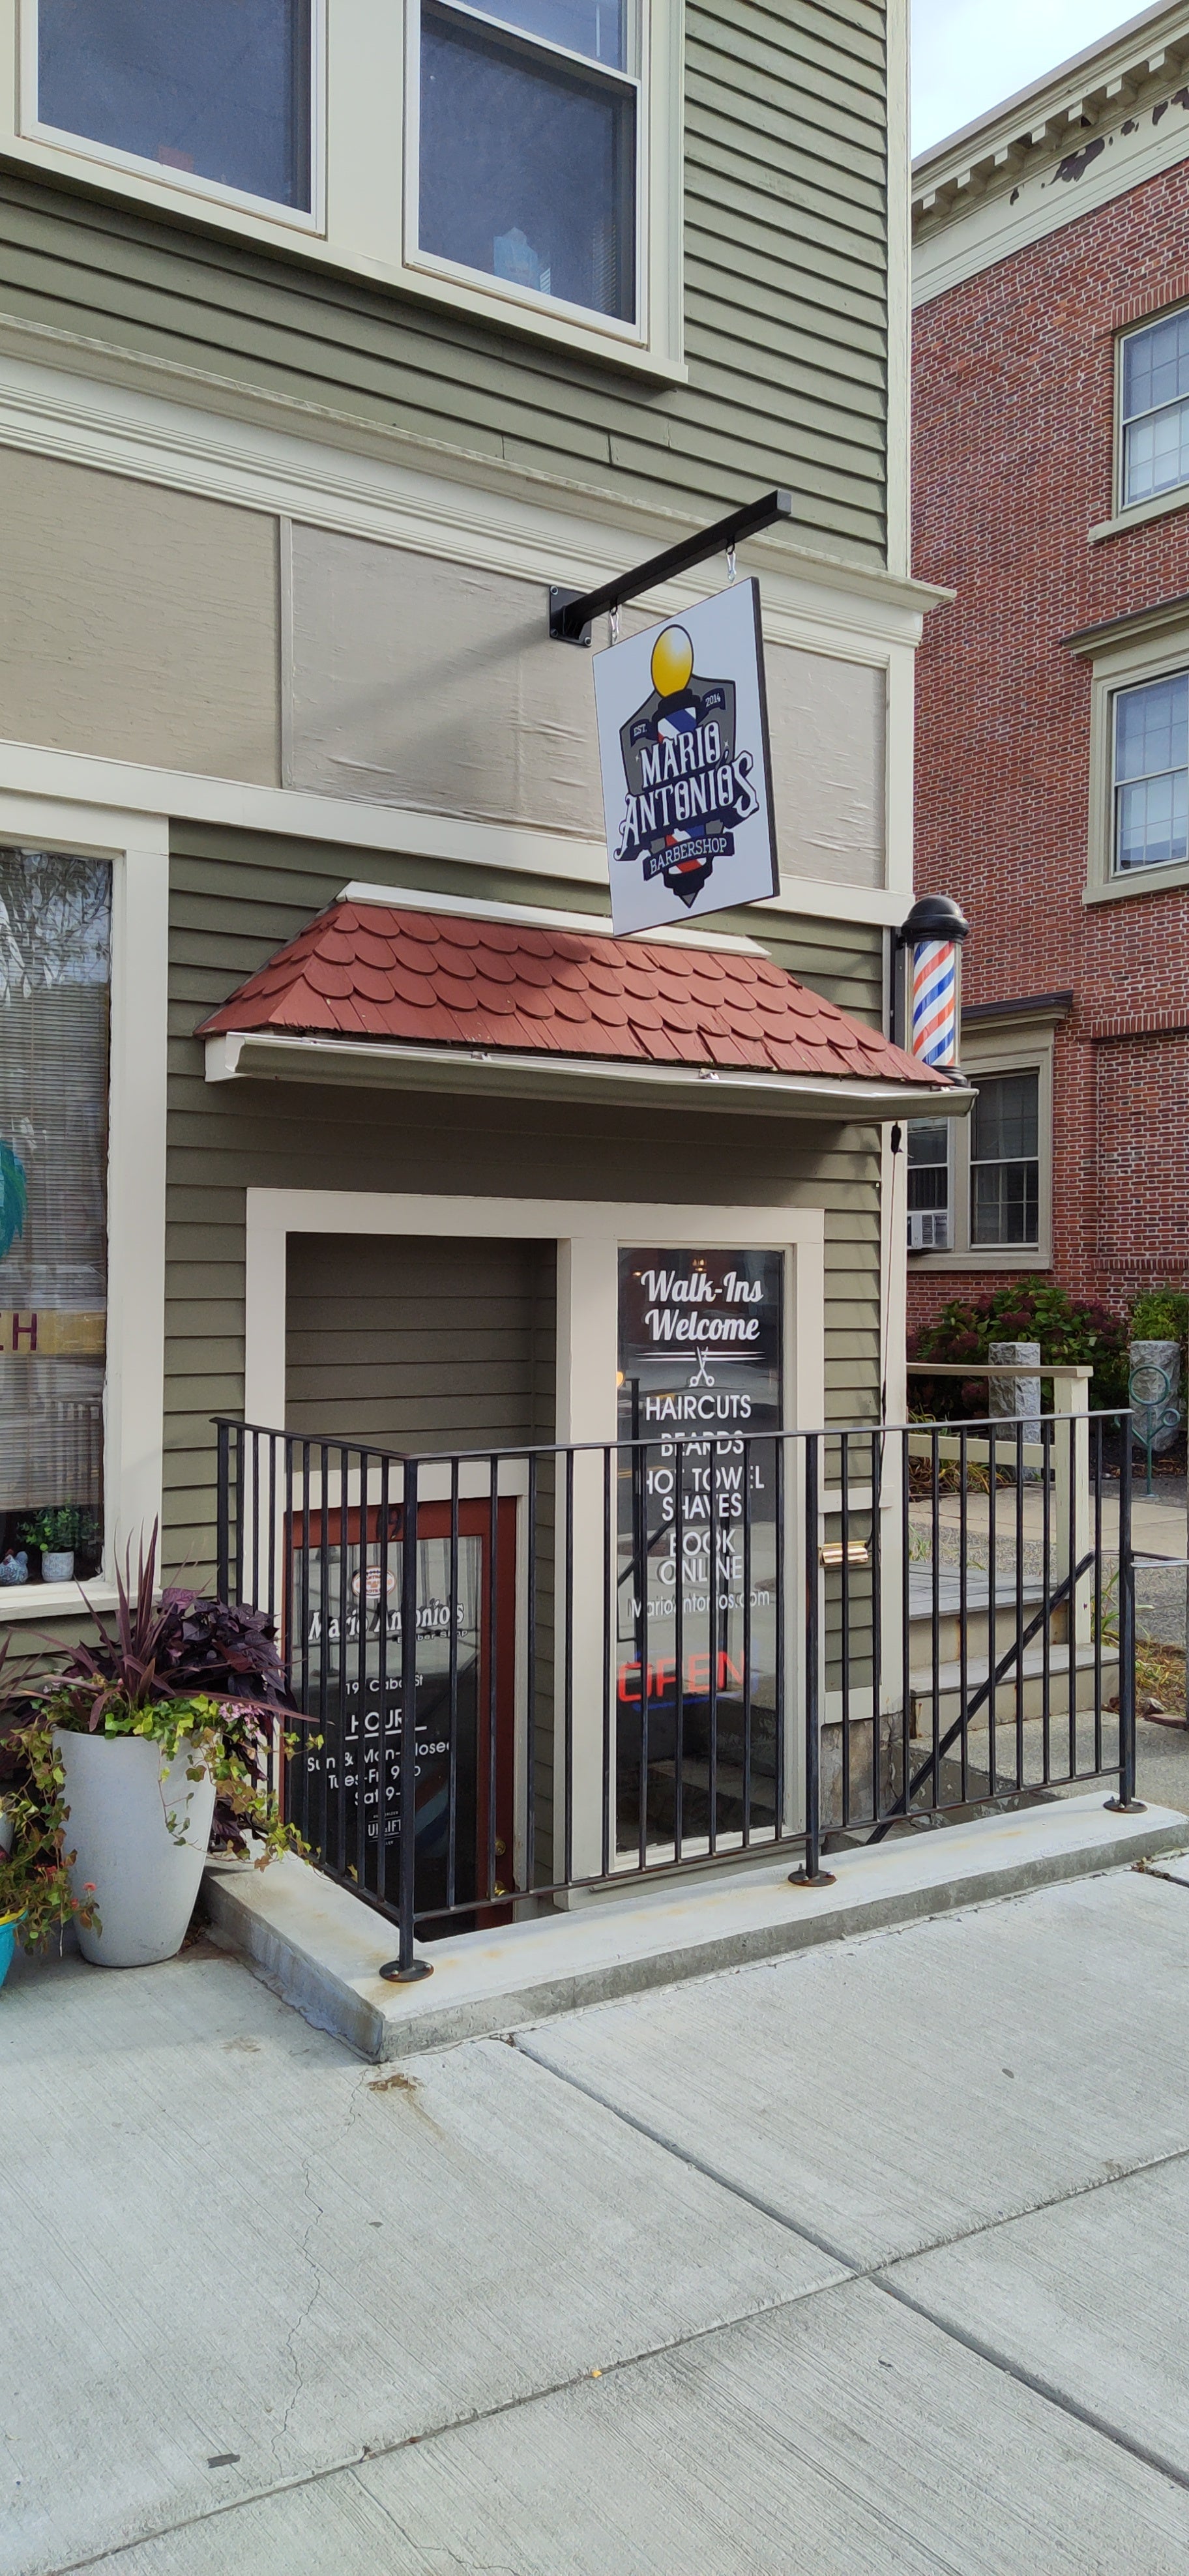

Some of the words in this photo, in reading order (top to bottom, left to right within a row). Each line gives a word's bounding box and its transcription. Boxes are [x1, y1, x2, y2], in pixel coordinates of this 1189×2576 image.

[633, 723, 647, 737] EST.
[705, 693, 722, 708] 2014
[639, 721, 721, 789] MARIO
[649, 837, 727, 875] BARBERSHOP
[640, 1270, 764, 1302] Walk-Ins
[0, 1312, 37, 1351] H
[645, 1308, 761, 1341] Welcome
[645, 1394, 752, 1421] HAIRCUTS
[639, 1467, 684, 1495] HO
[692, 1465, 765, 1492] TOWL
[659, 1555, 742, 1585] ONLNE
[351, 1708, 402, 1734] HOUR
